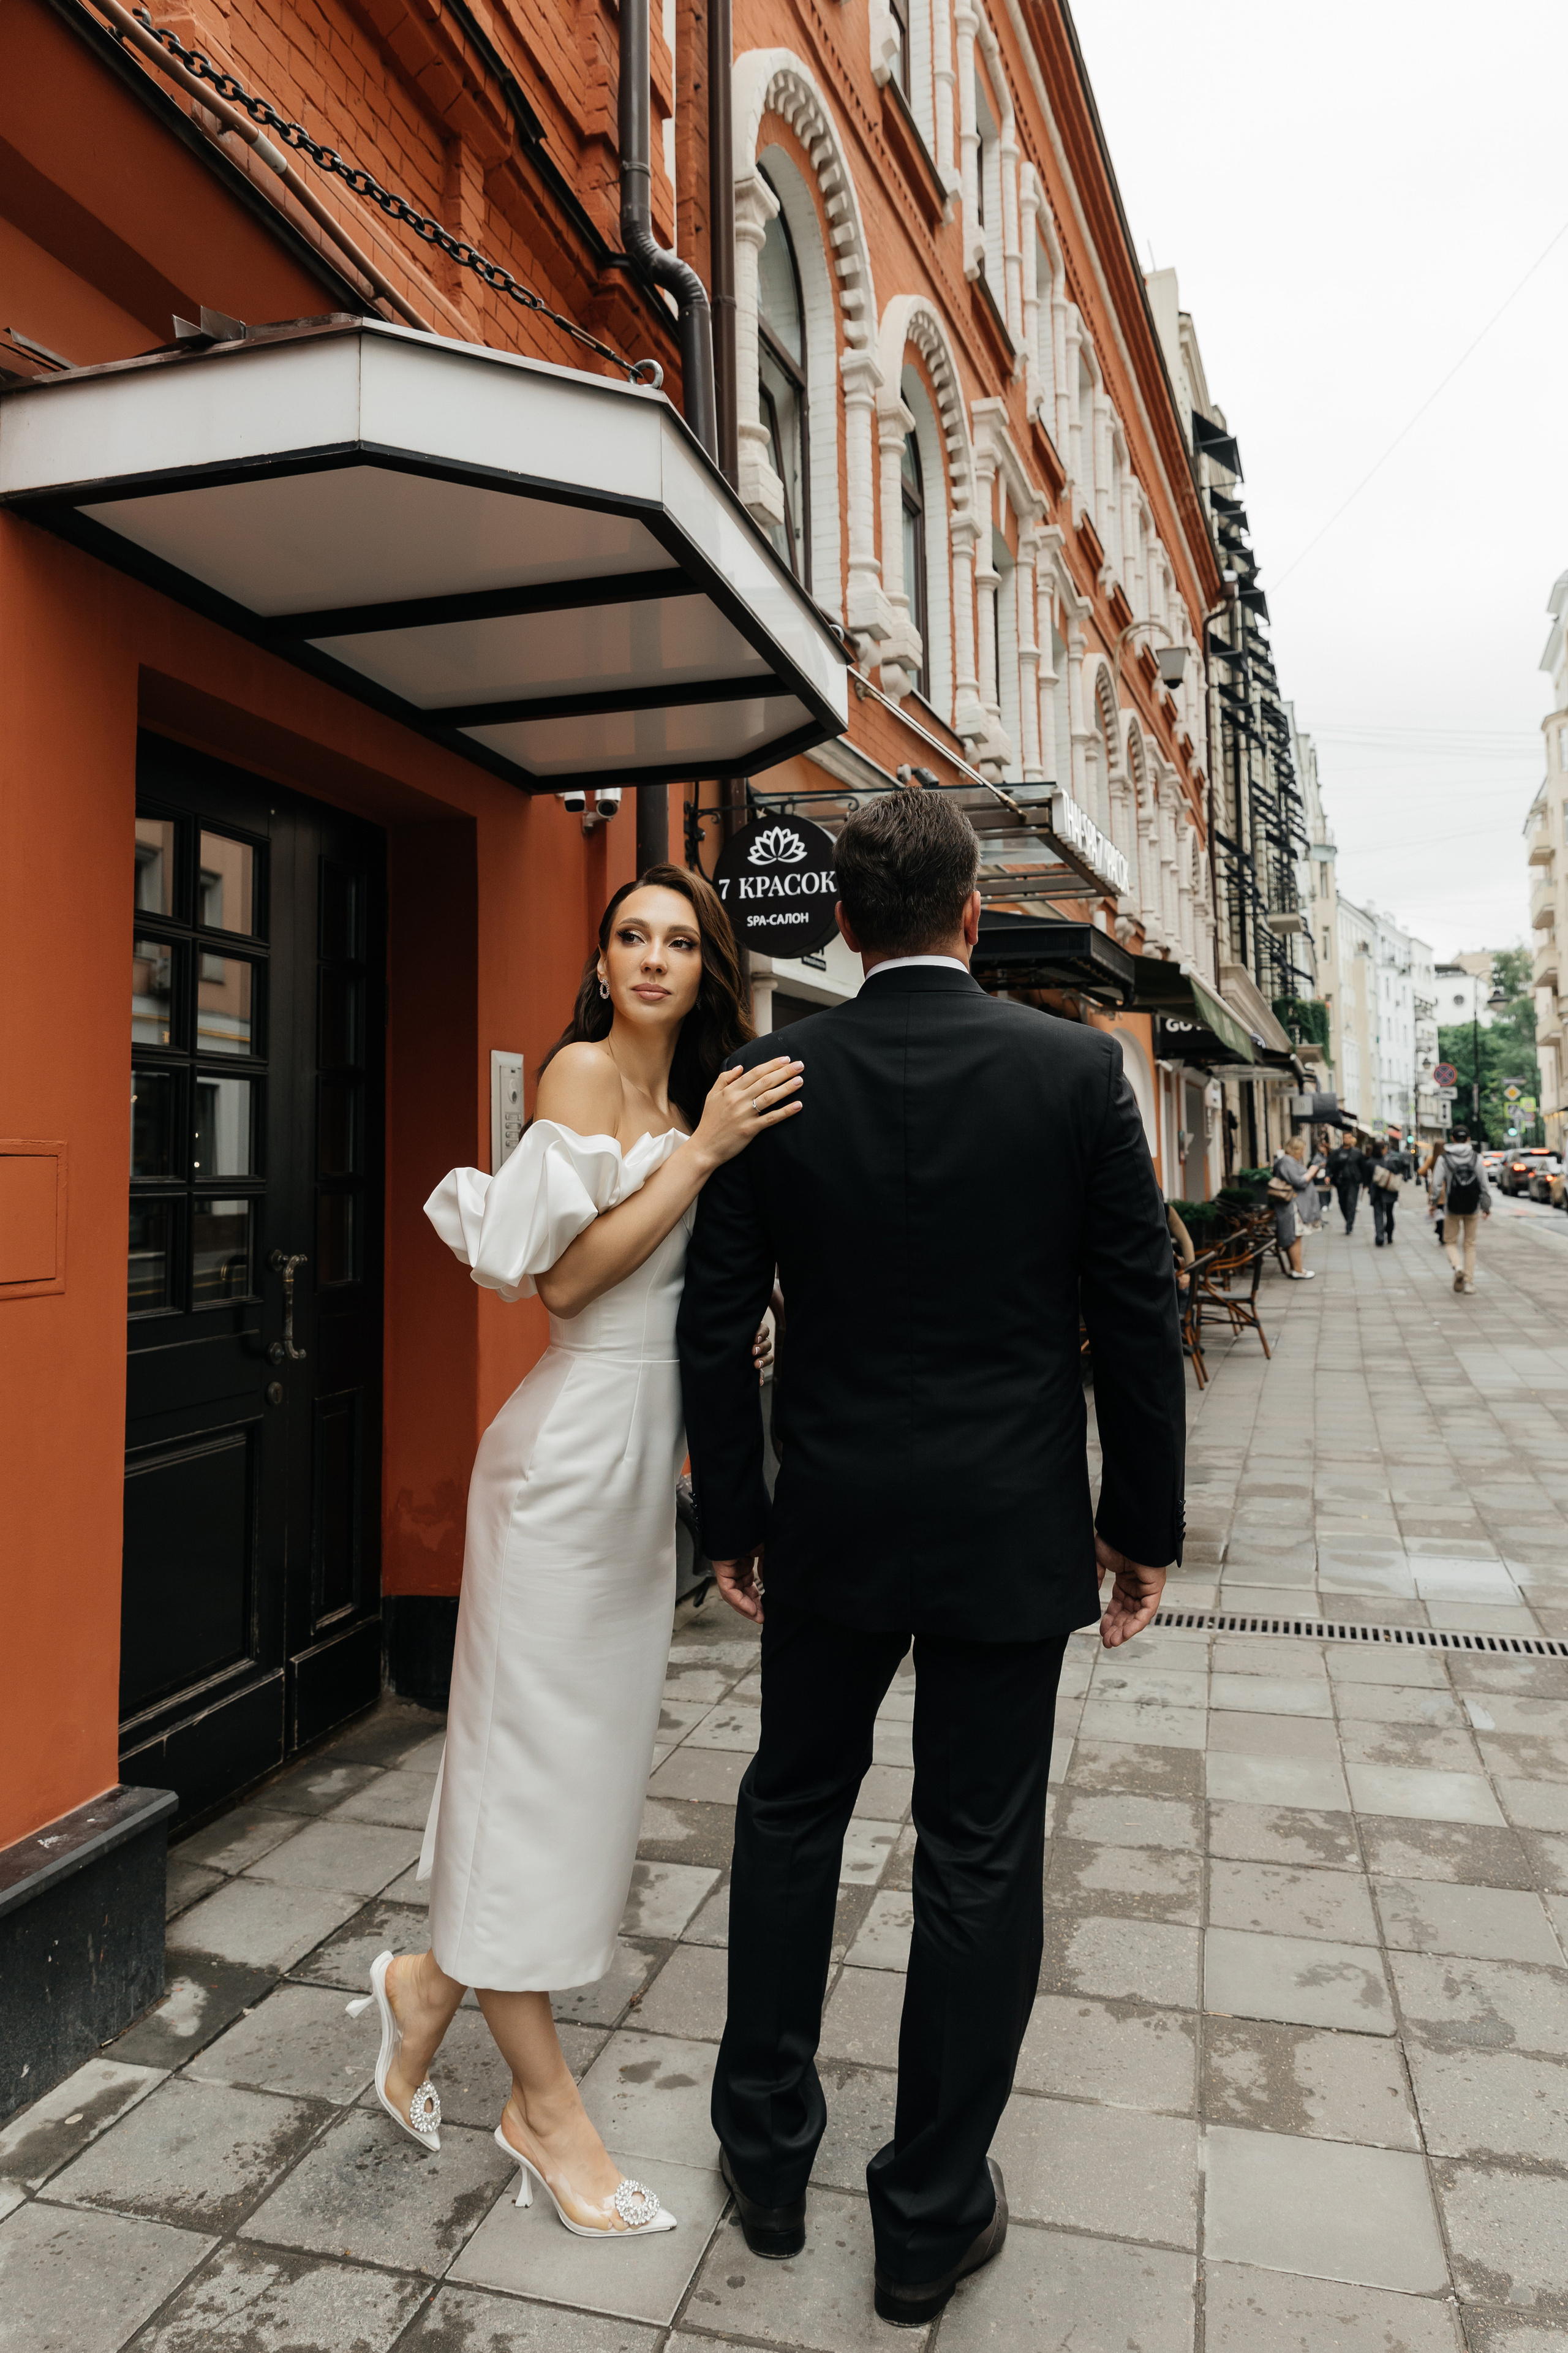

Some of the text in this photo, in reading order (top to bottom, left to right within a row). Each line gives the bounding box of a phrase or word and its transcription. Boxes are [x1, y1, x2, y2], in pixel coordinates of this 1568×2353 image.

[718, 871, 837, 900] 7 КРАСОК
[747, 912, 809, 927] SPA-САЛОН
